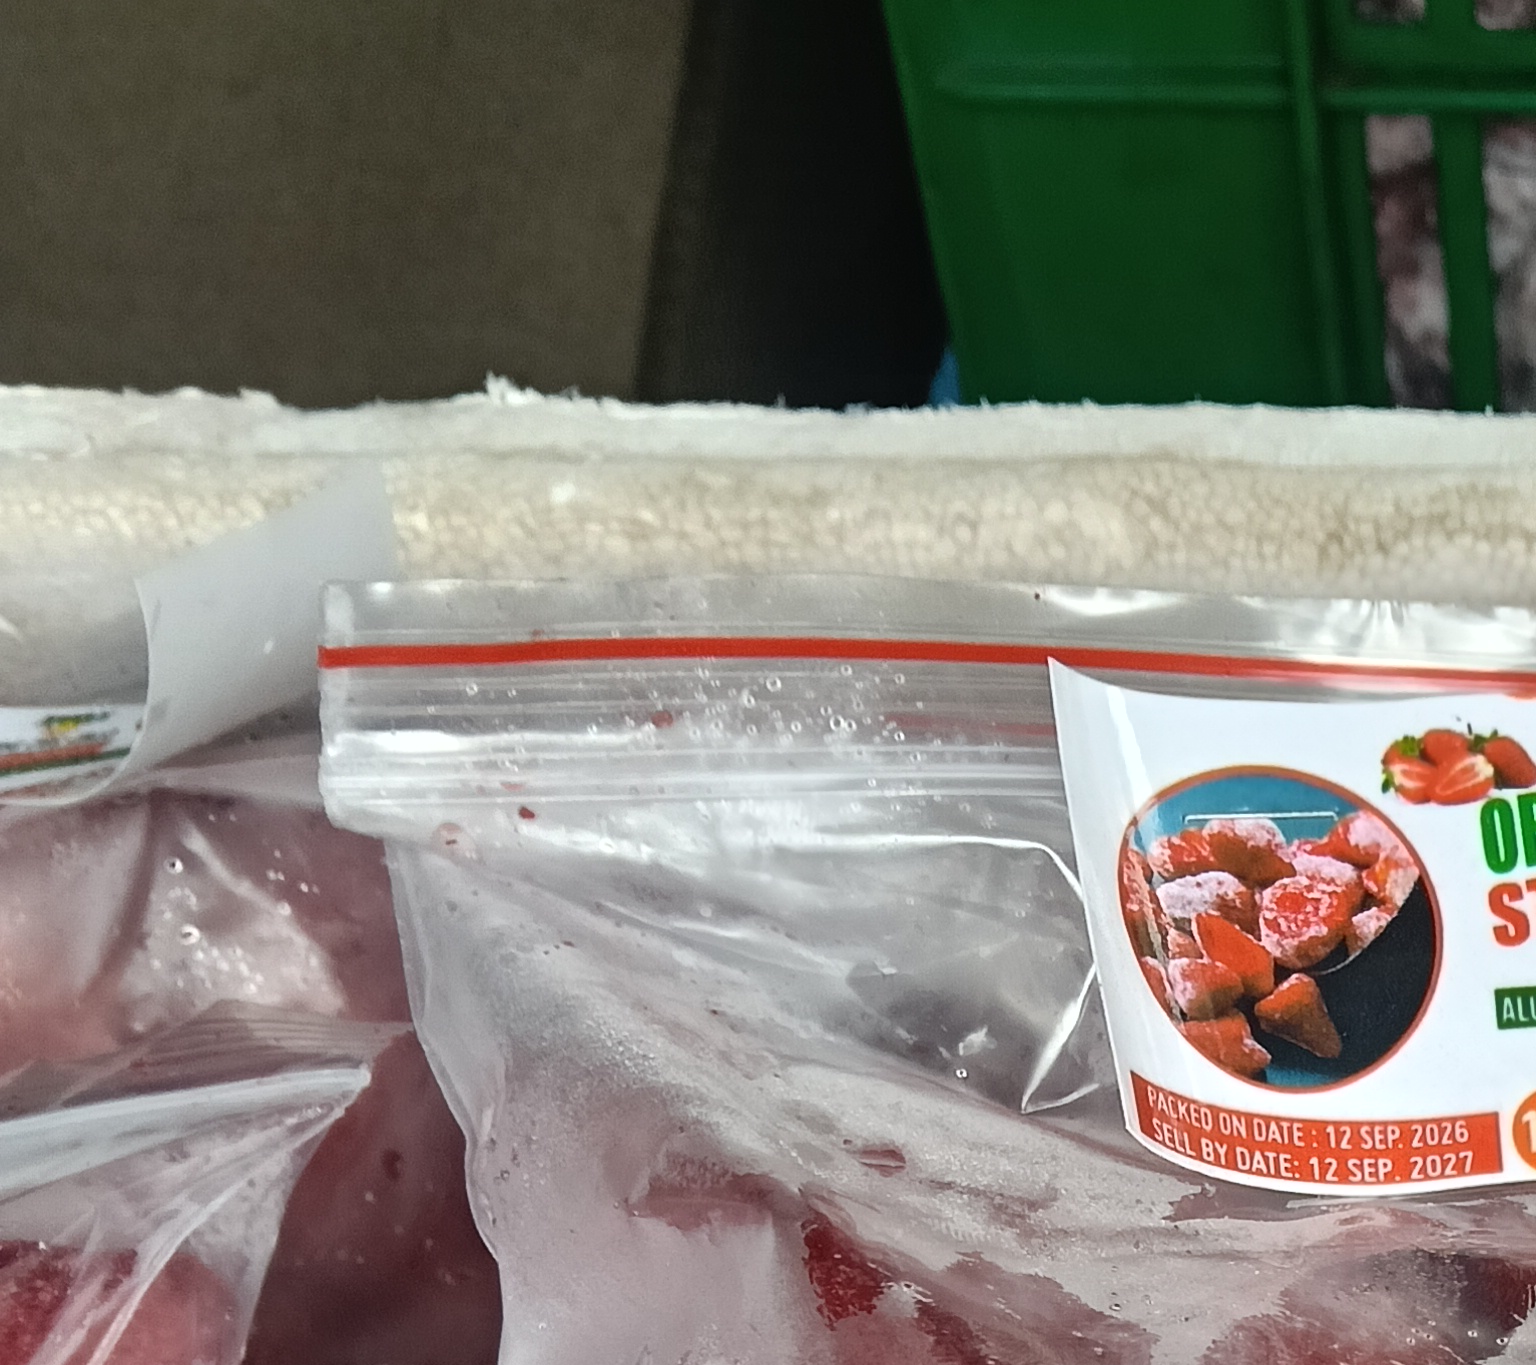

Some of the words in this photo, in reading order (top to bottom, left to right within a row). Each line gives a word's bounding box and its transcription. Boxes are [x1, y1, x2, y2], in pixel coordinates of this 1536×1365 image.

[1147, 1085, 1213, 1132] PACKED
[1218, 1112, 1247, 1140] ON
[1325, 1125, 1353, 1150] 12
[1359, 1123, 1404, 1150] SEP.
[1410, 1120, 1470, 1149] 2026
[1151, 1117, 1197, 1158] SELL
[1200, 1138, 1228, 1167] BY
[1235, 1146, 1300, 1180] DATE:
[1308, 1156, 1340, 1183] 12
[1409, 1150, 1474, 1180] 2027
